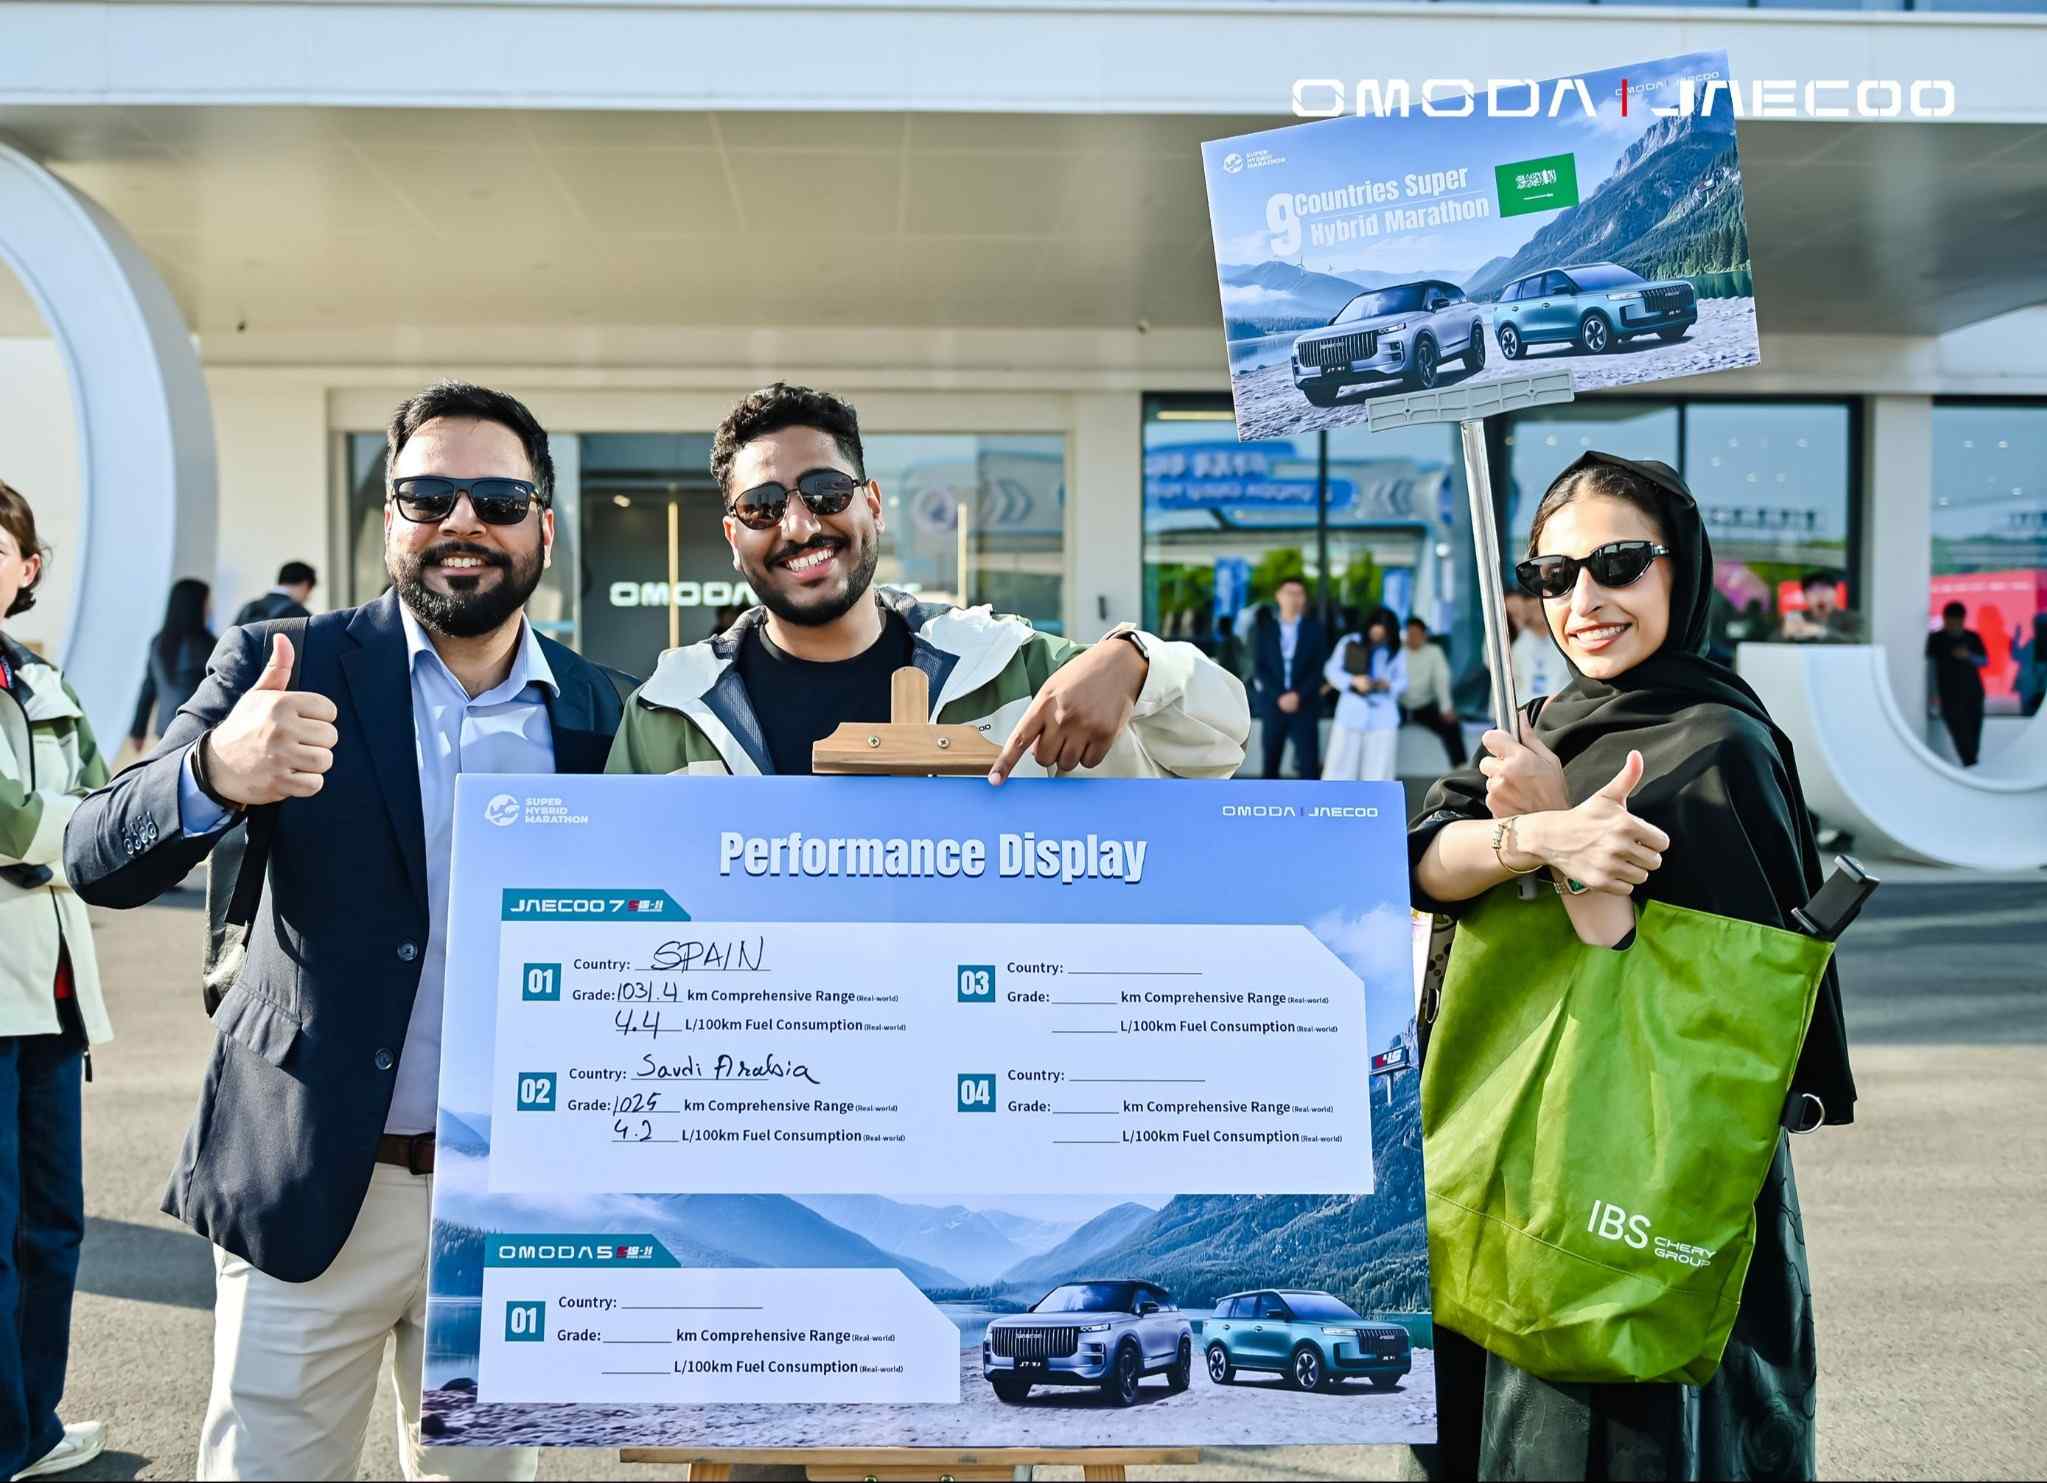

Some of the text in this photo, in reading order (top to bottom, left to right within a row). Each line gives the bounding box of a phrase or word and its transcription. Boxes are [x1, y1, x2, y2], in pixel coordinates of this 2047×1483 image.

[1266, 166, 1469, 257] 9 Countries Super
[1311, 196, 1490, 249] Hybrid Marathon
[610, 581, 761, 607] OMODA
[526, 798, 562, 806] SUPER
[526, 807, 568, 815] HYBRID
[1222, 806, 1378, 818] OMODA JAECOO
[525, 815, 589, 824] MARATHON
[720, 831, 1147, 884] Performance Display
[510, 899, 605, 912] JAECOO
[609, 899, 625, 912] 7
[650, 936, 764, 973] SPAIN
[573, 958, 631, 973] Country:
[1007, 962, 1064, 976] Country:
[528, 968, 554, 993] 01
[960, 970, 990, 995] 03
[573, 988, 616, 1001] Grade:
[616, 981, 678, 1003] 1031.4
[687, 989, 708, 1001] km
[711, 989, 812, 1004] Comprehensive
[816, 990, 855, 1004] Range
[1007, 991, 1050, 1003] Grade:
[1121, 991, 1142, 1003] km
[1144, 991, 1244, 1006] Comprehensive
[1247, 992, 1287, 1007] Range
[615, 1008, 660, 1040] 4.4
[685, 1018, 742, 1033] L/100km
[745, 1018, 773, 1031] Fuel
[776, 1018, 864, 1033] Consumption
[1120, 1020, 1177, 1034] L/100km
[1180, 1020, 1207, 1033] Fuel
[1209, 1020, 1296, 1035] Consumption
[568, 1067, 627, 1082] Country:
[636, 1053, 821, 1084] Saudi Arabia
[1007, 1068, 1065, 1083] Country:
[520, 1078, 550, 1104] 02
[960, 1079, 991, 1105] 04
[567, 1100, 611, 1112] Grade:
[612, 1091, 662, 1117] 1025
[684, 1099, 705, 1112] km
[708, 1099, 810, 1114] Comprehensive
[814, 1100, 854, 1115] Range
[1007, 1100, 1052, 1112] Grade:
[1123, 1101, 1144, 1113] km
[1146, 1100, 1248, 1116] Comprehensive
[1250, 1102, 1291, 1116] Range
[613, 1118, 652, 1142] 4.2
[681, 1128, 739, 1143] L/100km
[743, 1128, 771, 1141] Fuel
[774, 1129, 862, 1144] Consumption
[1122, 1130, 1180, 1144] L/100km
[1182, 1130, 1211, 1143] Fuel
[1213, 1130, 1300, 1145] Consumption
[1587, 1199, 1652, 1249] IBS
[1653, 1236, 1717, 1259] CHERY
[1654, 1248, 1712, 1268] GROUP
[558, 1295, 617, 1311] Country:
[510, 1306, 537, 1334] 01
[557, 1329, 601, 1342] Grade:
[676, 1329, 697, 1342] km
[700, 1329, 806, 1344] Comprehensive
[809, 1329, 851, 1345] Range
[674, 1360, 733, 1375] L/100km
[736, 1360, 765, 1373] Fuel
[768, 1360, 858, 1376] Consumption
